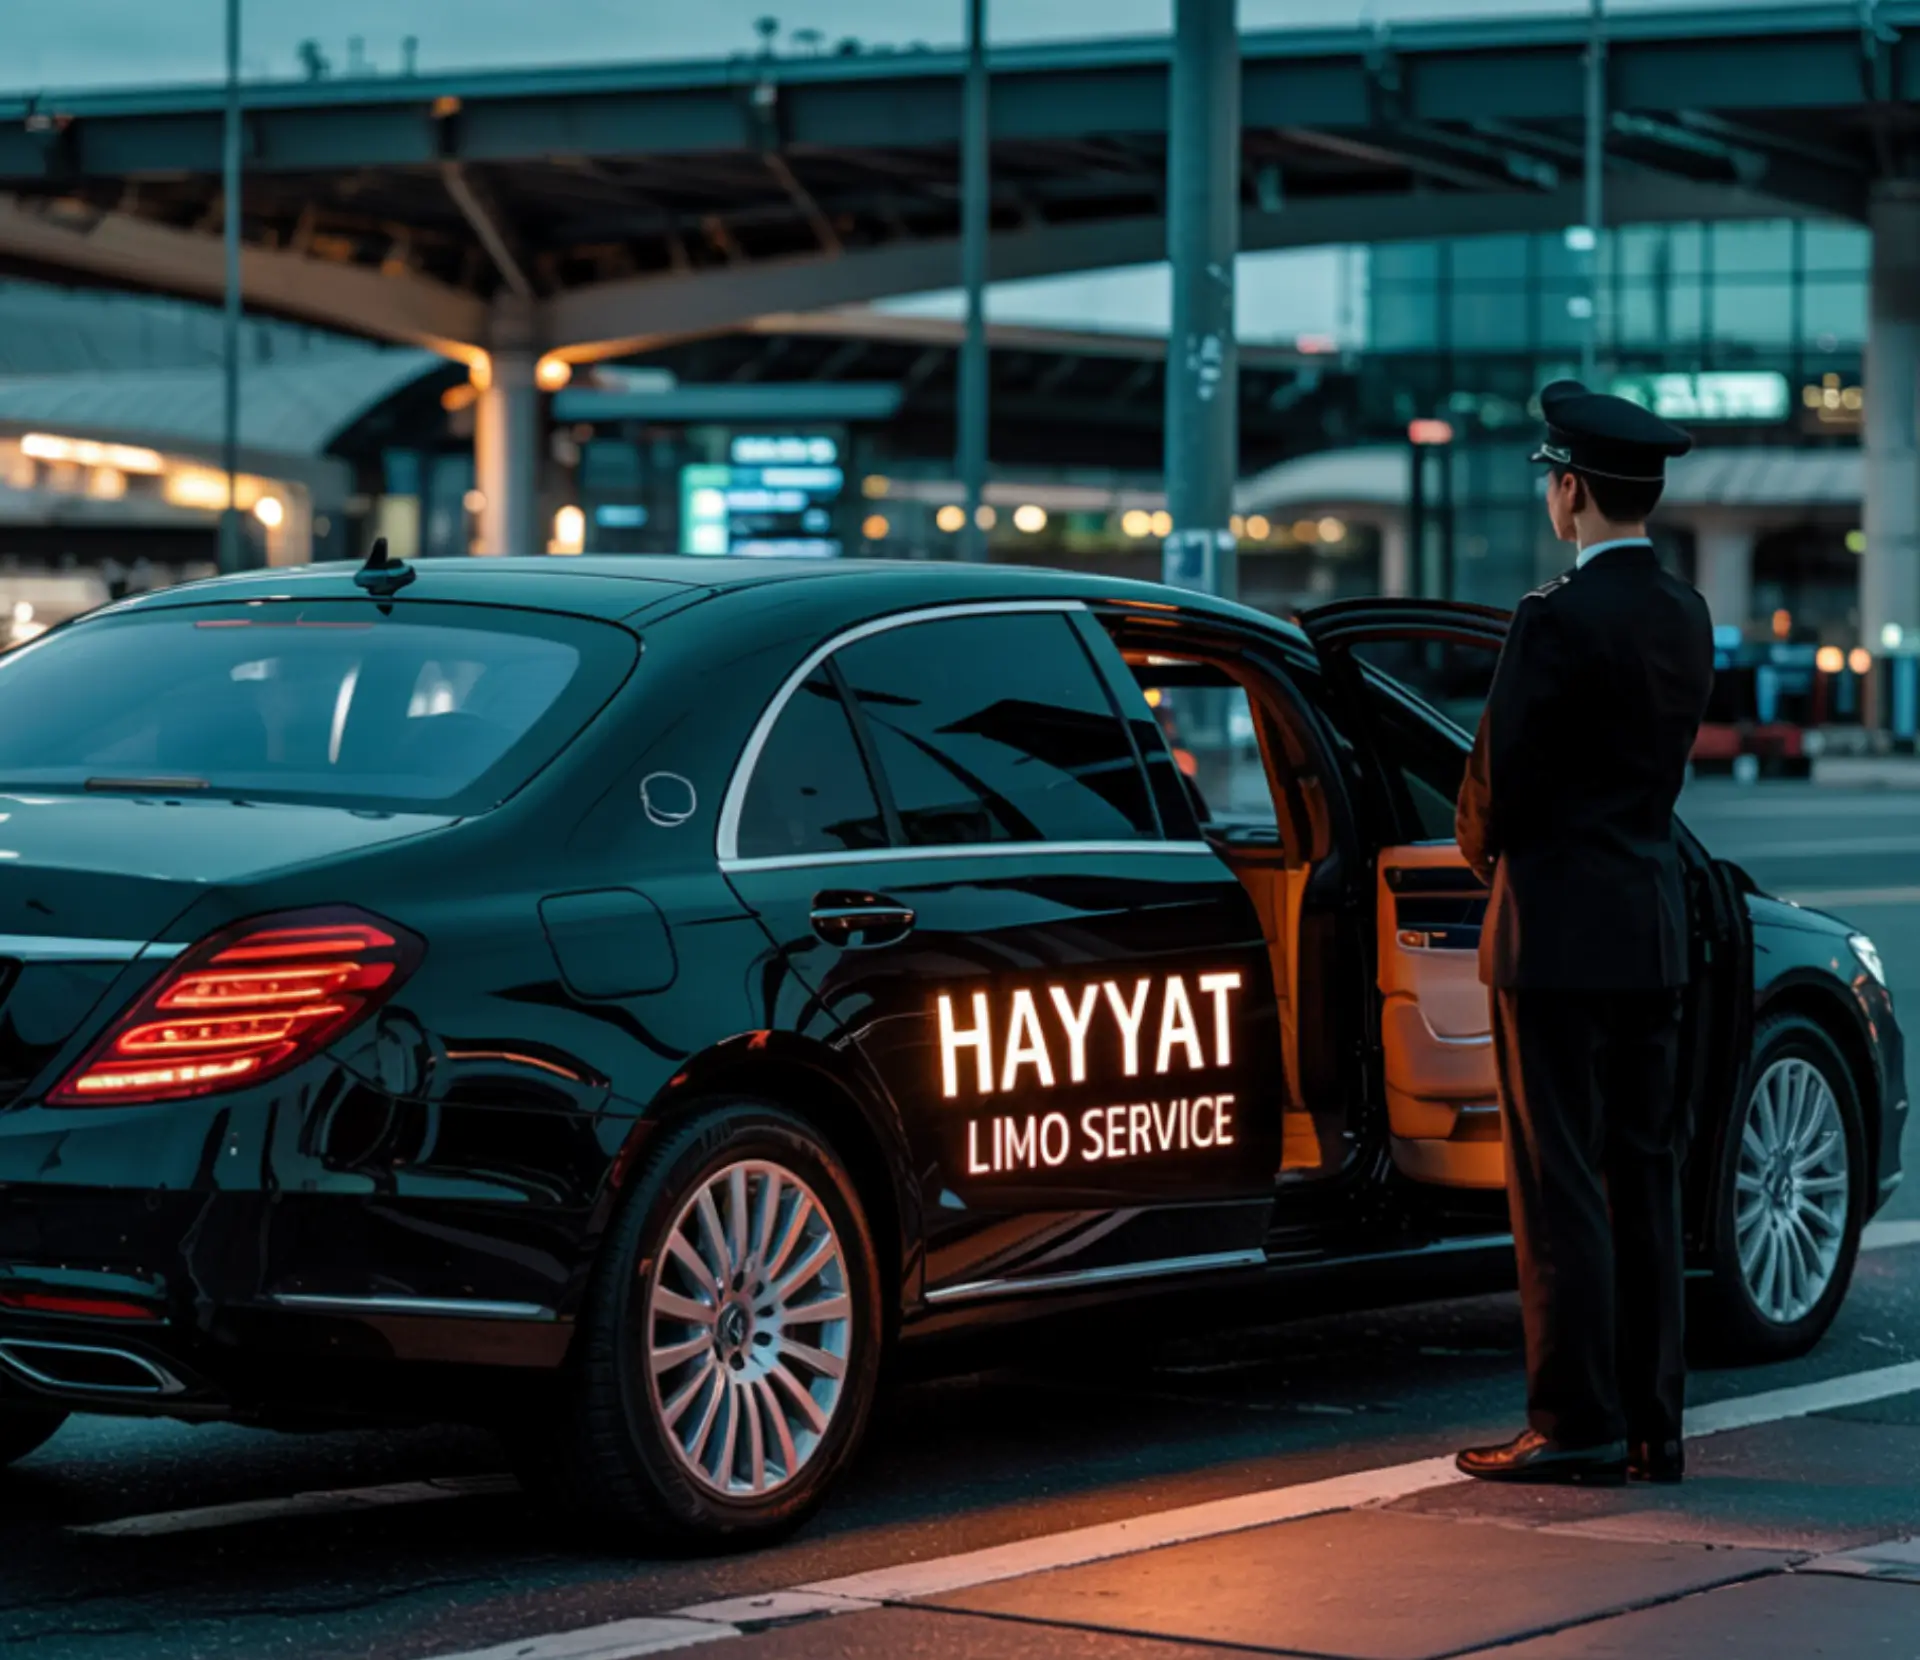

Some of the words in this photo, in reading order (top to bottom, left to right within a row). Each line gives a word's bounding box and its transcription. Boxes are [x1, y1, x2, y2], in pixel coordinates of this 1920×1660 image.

[937, 972, 1242, 1098] HAYYAT
[968, 1112, 1070, 1174] LIMO
[1081, 1095, 1235, 1161] SERVICE
